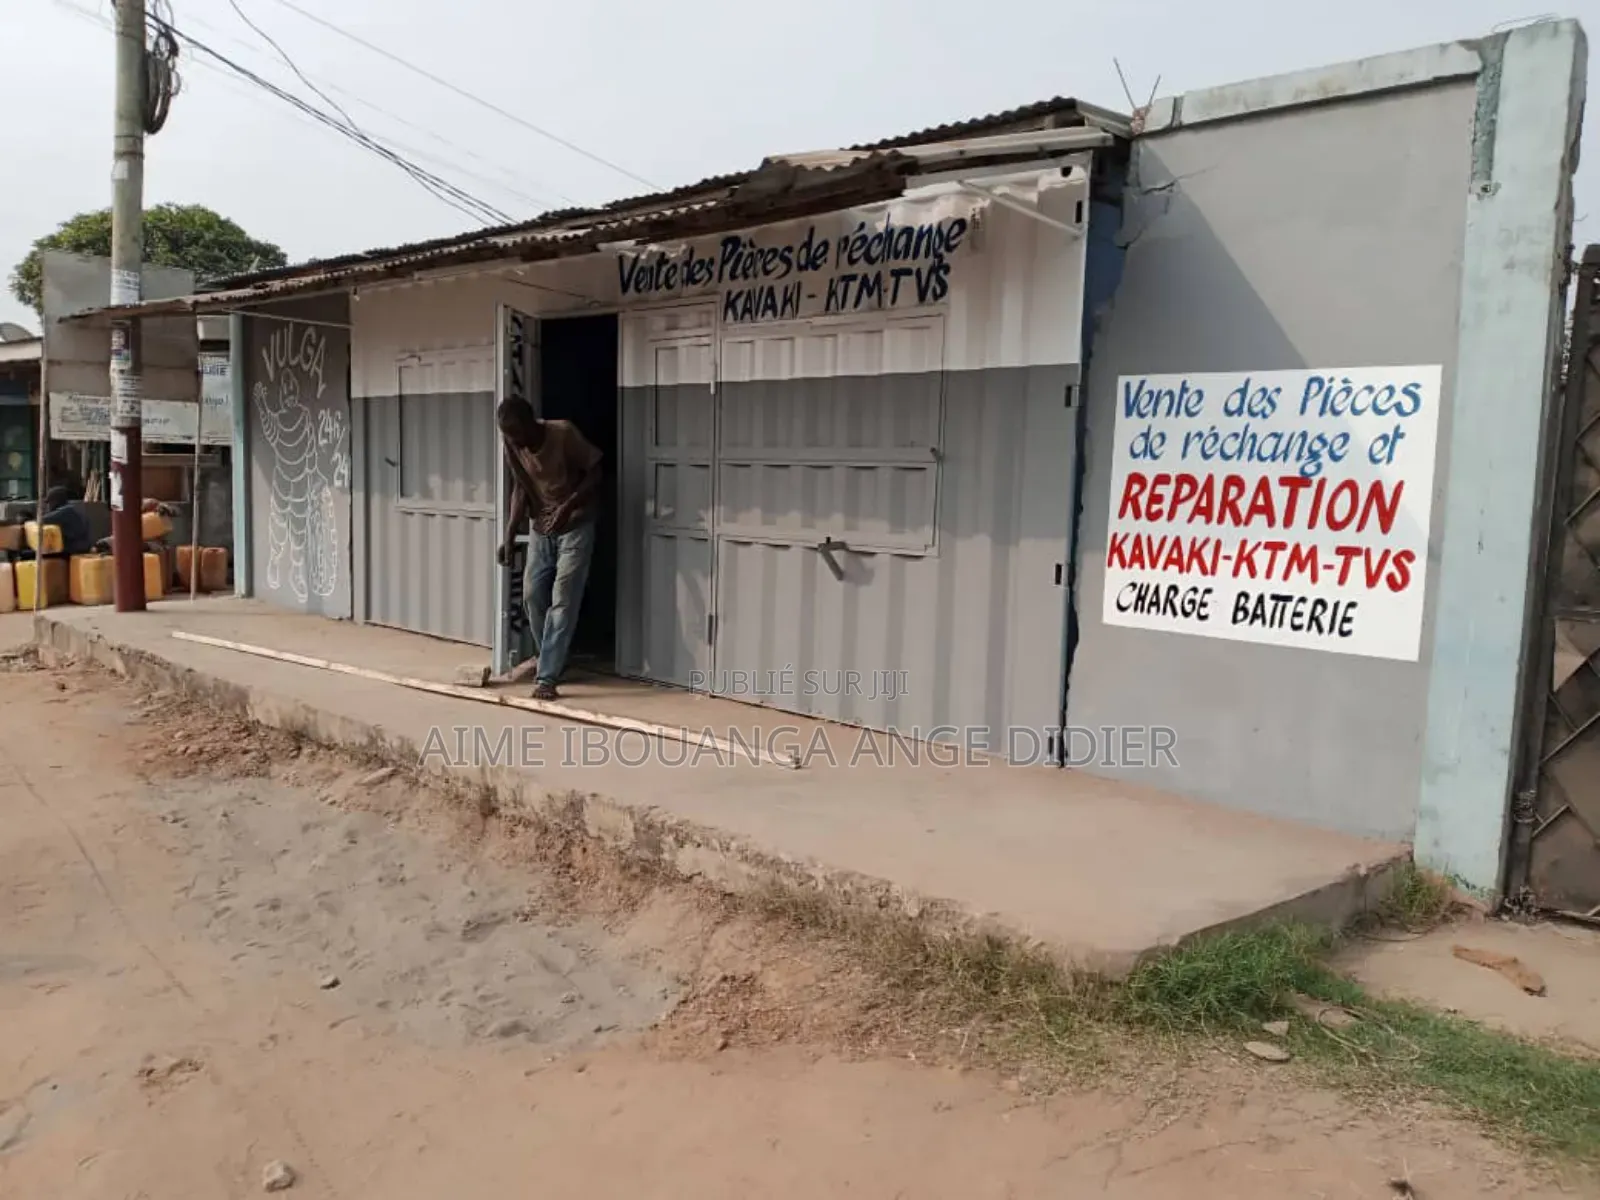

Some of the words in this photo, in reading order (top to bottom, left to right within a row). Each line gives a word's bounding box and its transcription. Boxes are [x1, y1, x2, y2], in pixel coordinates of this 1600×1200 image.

[617, 250, 679, 296] Vente
[681, 246, 715, 289] des
[797, 225, 830, 272] de
[835, 211, 968, 269] réchange
[262, 321, 327, 399] VULGA
[1122, 378, 1204, 420] Vente
[1223, 377, 1283, 420] des
[1299, 375, 1424, 417] Pièces
[1129, 424, 1167, 461] de
[1181, 422, 1351, 478] réchange
[1368, 424, 1407, 465] et
[1117, 471, 1405, 536] REPARATION
[1115, 581, 1214, 622] CHARGE
[1230, 590, 1359, 638] BATTERIE
